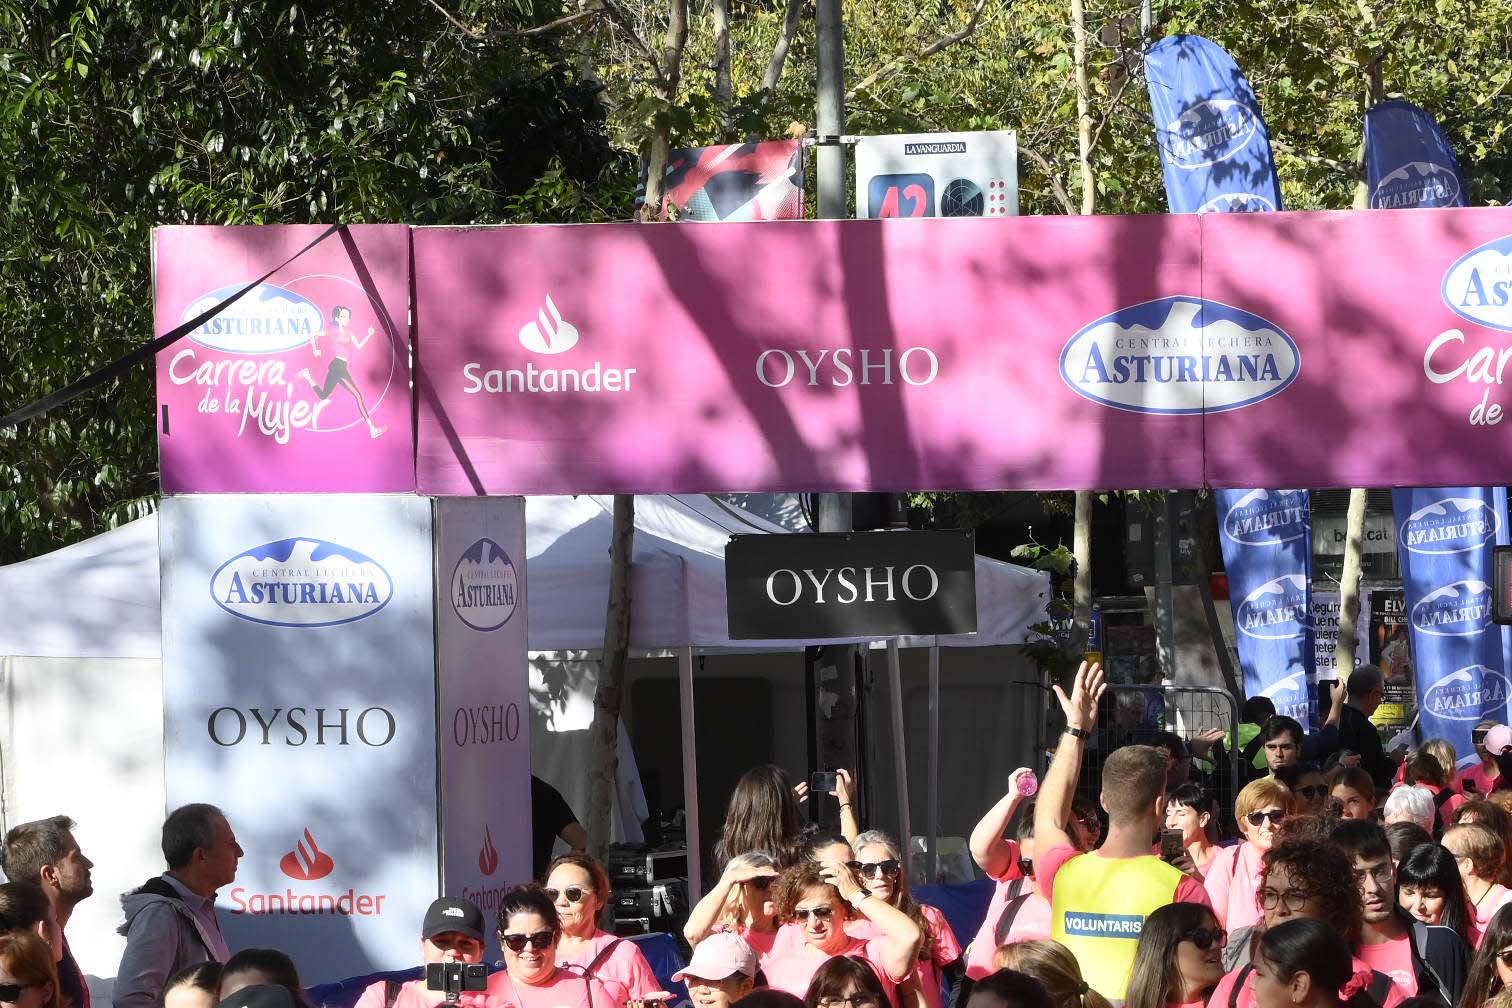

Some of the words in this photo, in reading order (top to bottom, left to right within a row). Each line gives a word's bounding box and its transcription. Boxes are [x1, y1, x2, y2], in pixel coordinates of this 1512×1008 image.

[912, 143, 966, 154] VANGUARDIA
[1115, 337, 1189, 351] CENTRA
[168, 348, 287, 386] Carrera
[463, 362, 637, 394] Santander
[755, 346, 940, 388] OYSHO
[1080, 347, 1281, 384] ASTURIANA
[198, 387, 219, 413] de
[224, 386, 241, 413] la
[237, 383, 332, 444] Mujer
[1469, 392, 1502, 427] de
[223, 571, 380, 605] ASTURIANA
[252, 568, 310, 577] CENTRAL
[766, 564, 938, 606] OYSHO
[456, 576, 518, 609] ASTURIANA
[207, 706, 397, 748] OYSHO
[454, 702, 520, 749] OYSHO
[230, 887, 386, 916] Santander
[1065, 916, 1142, 936] VOLUNTARIS
